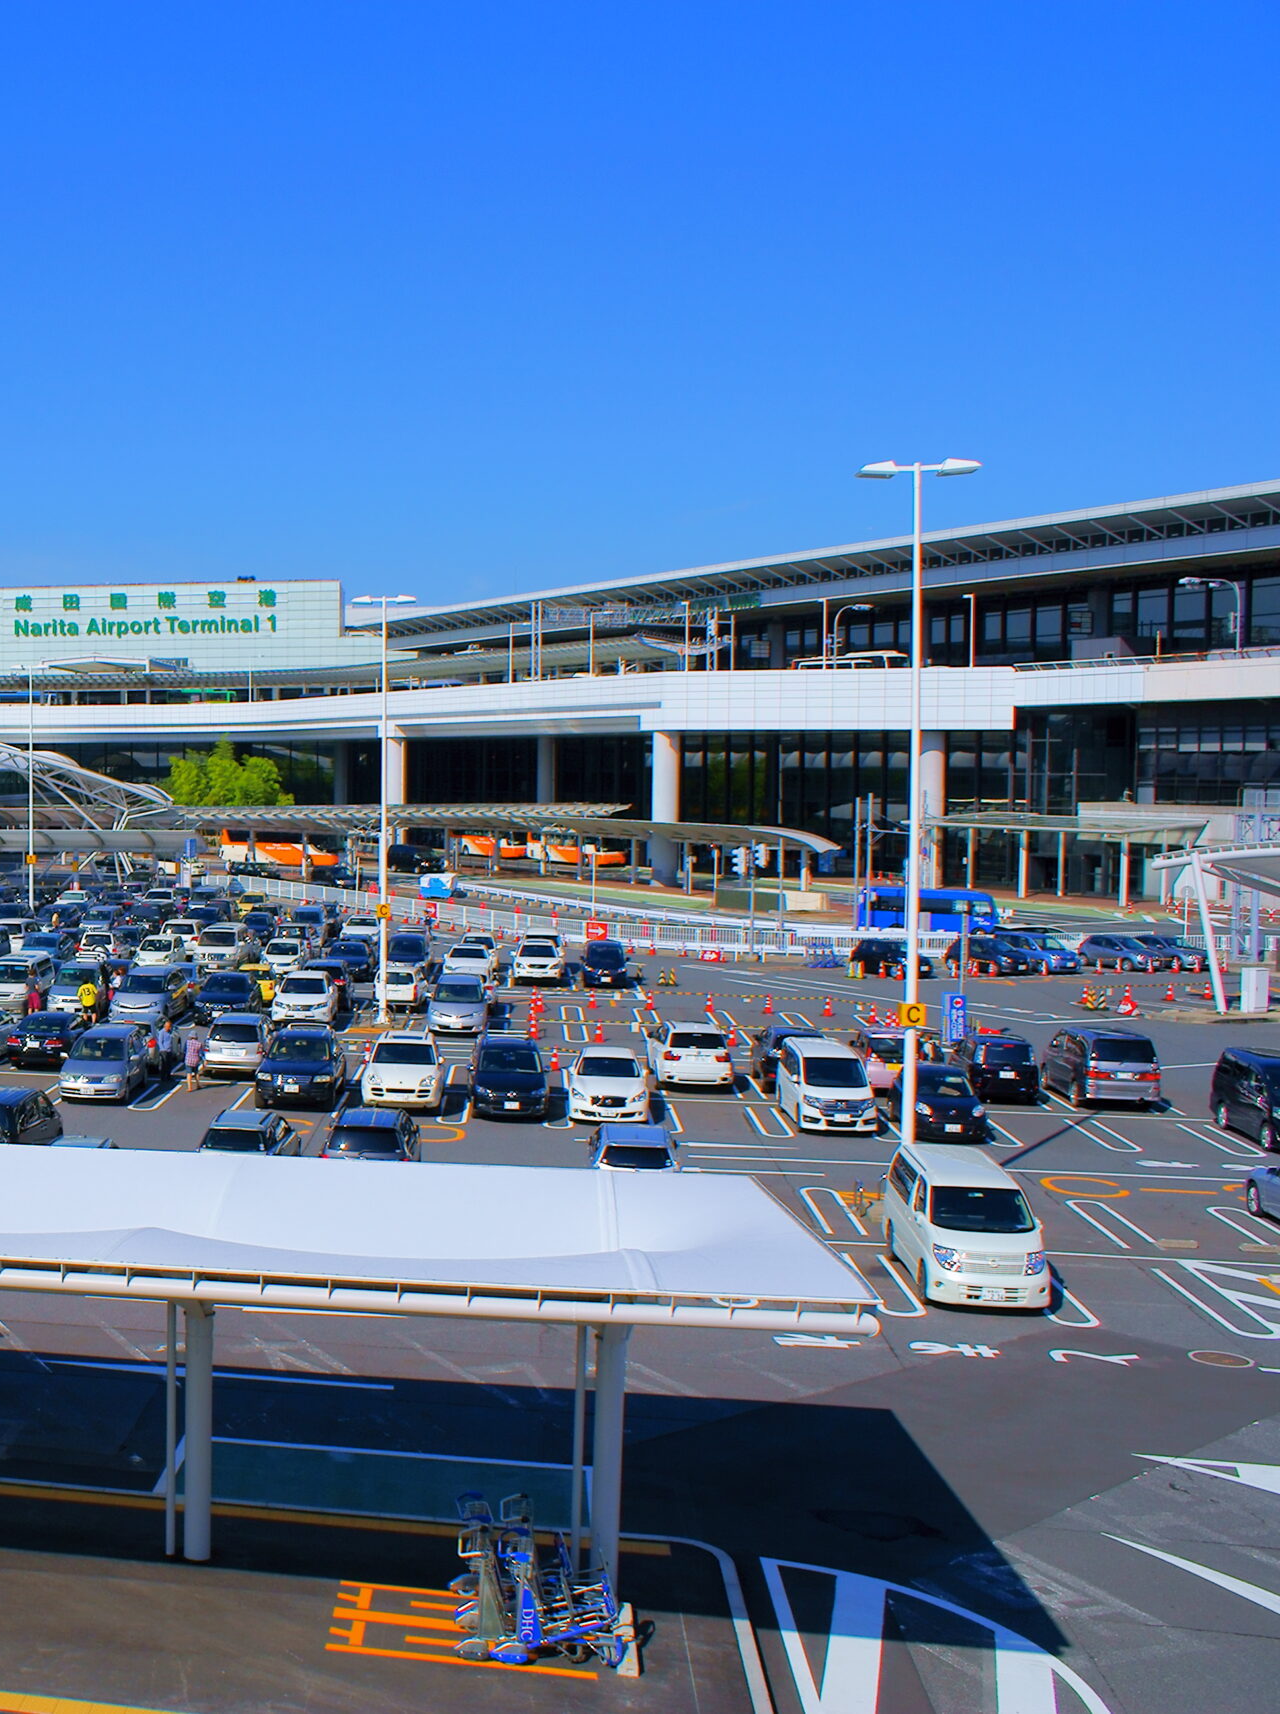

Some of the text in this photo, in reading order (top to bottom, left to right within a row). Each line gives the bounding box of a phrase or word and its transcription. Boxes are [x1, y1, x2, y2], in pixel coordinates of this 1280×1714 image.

[14, 614, 277, 639] Narita Airport Terminal 1
[380, 905, 388, 916] C
[907, 1006, 921, 1024] C
[520, 1608, 535, 1641] DHC
